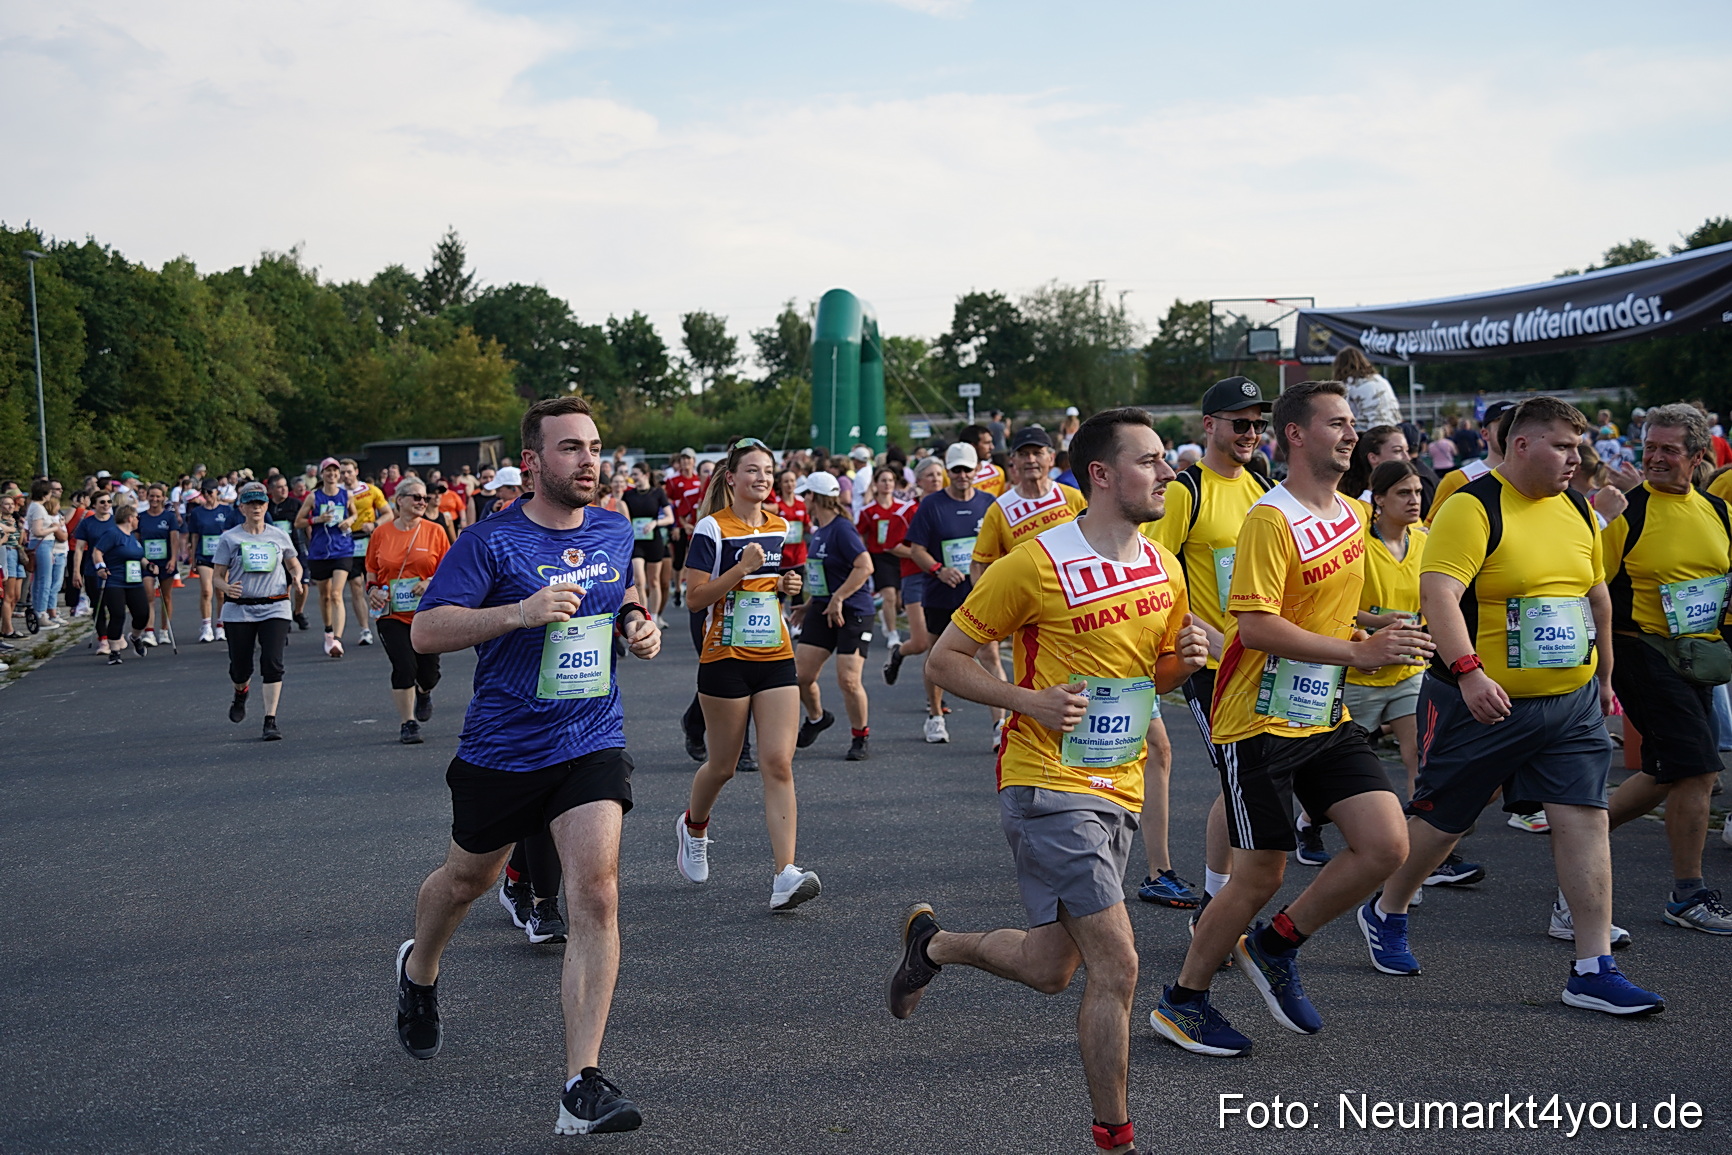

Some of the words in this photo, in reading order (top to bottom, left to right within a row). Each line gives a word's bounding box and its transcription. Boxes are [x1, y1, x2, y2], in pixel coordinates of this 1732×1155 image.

[1360, 326, 1395, 354] Hier
[1395, 319, 1469, 361] gewinnt
[1471, 315, 1510, 347] das
[1512, 292, 1674, 344] Miteinander.
[1012, 520, 1039, 539] MAX
[1041, 508, 1072, 525] BÖGL
[1302, 556, 1342, 586] MAX
[1342, 537, 1365, 565] BÖG
[396, 592, 416, 600] 1060
[1070, 603, 1131, 635] MAX
[1135, 591, 1173, 617] BÖGL
[1685, 601, 1717, 618] 2344
[748, 615, 771, 627] 873
[1533, 626, 1576, 641] 2345
[558, 650, 599, 669] 2851
[556, 672, 578, 680] Marco
[579, 671, 602, 679] Benkler
[1292, 675, 1330, 697] 1695
[1289, 694, 1312, 706] Fabian
[1089, 715, 1131, 734] 1821
[1069, 736, 1114, 746] Maximilian
